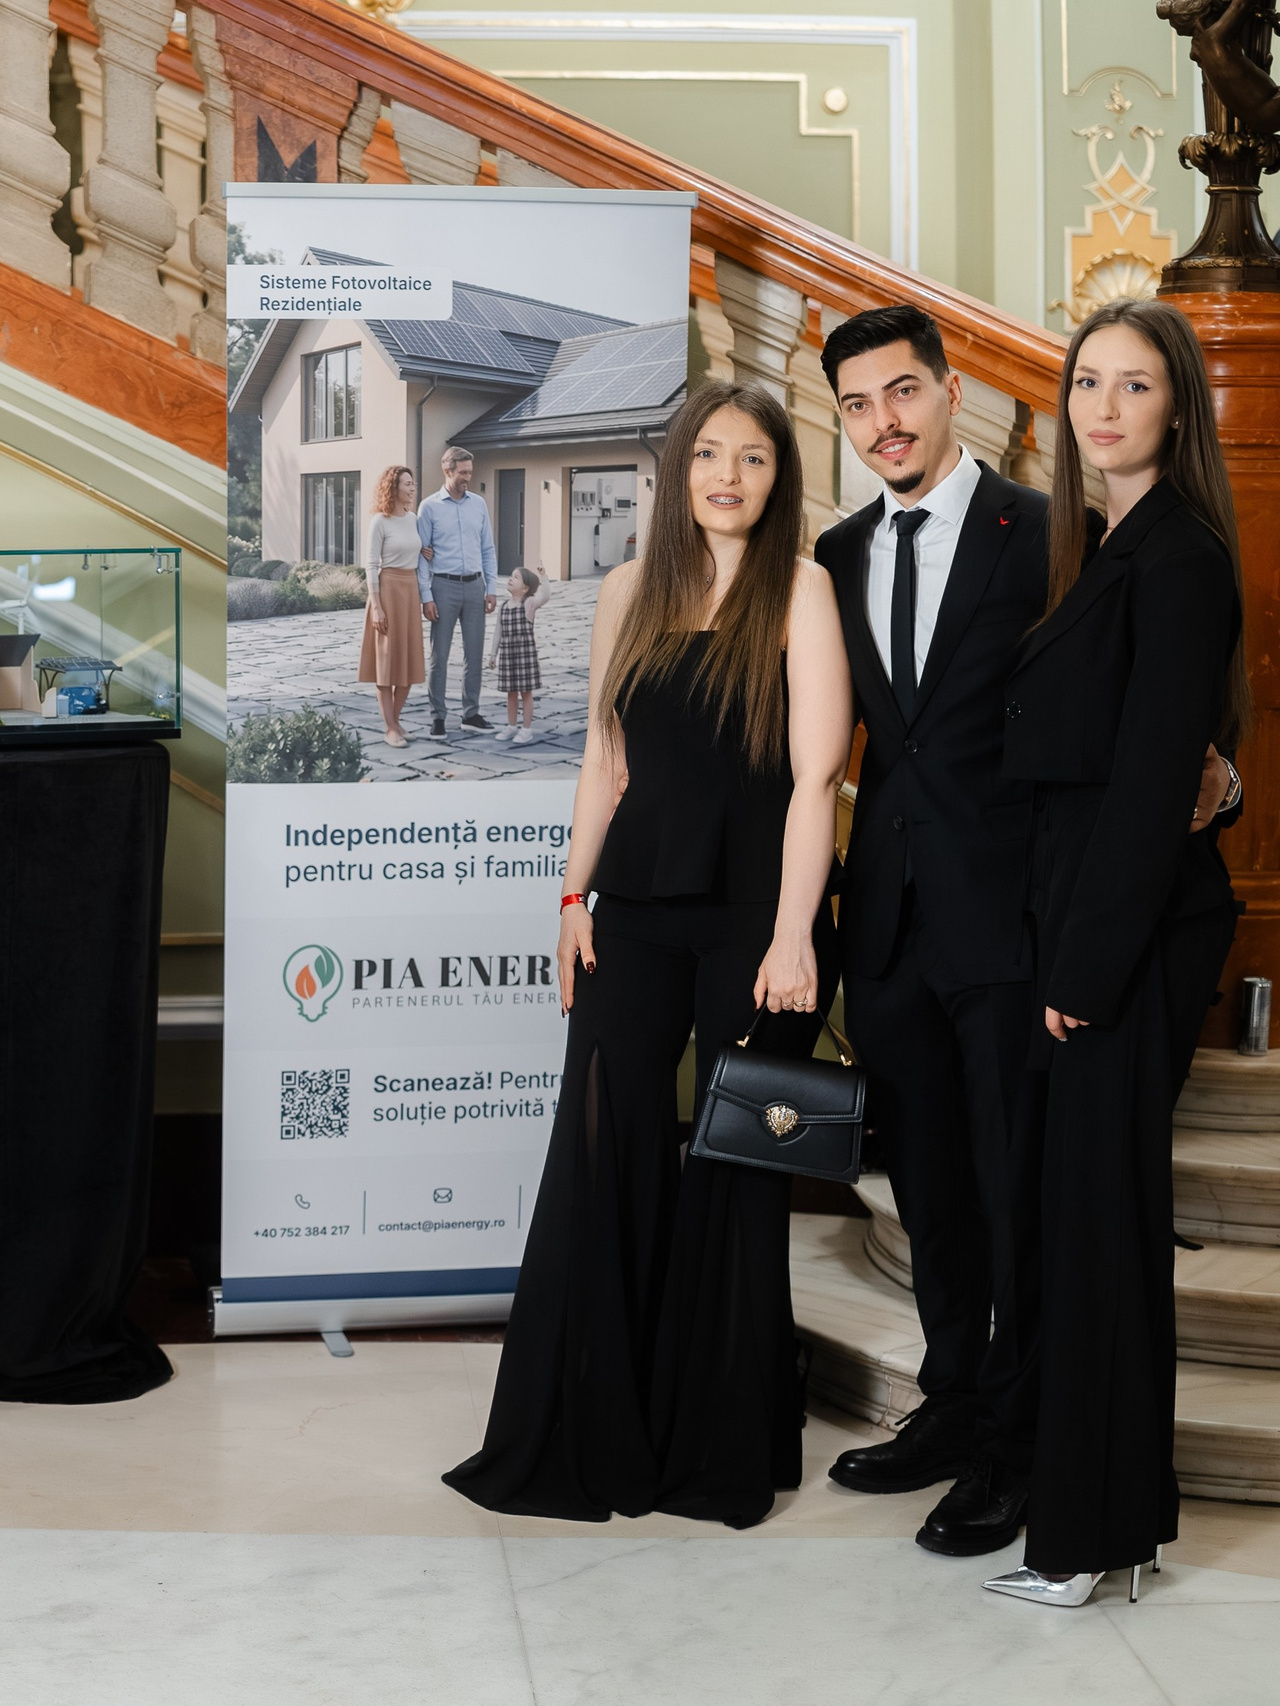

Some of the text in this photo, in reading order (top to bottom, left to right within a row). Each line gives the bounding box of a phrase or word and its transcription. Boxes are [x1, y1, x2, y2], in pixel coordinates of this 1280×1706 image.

[259, 274, 433, 291] Sisteme Fotovoltaice
[259, 296, 363, 315] Rezidențiale
[285, 819, 478, 851] Independență
[285, 860, 373, 888] pentru
[382, 862, 445, 880] casa
[454, 855, 476, 885] și
[352, 954, 554, 991] PIA ENER
[352, 994, 464, 1008] PARTENERUL
[473, 991, 504, 1006] TĂU
[373, 1071, 563, 1093] Scanează! Pentr
[373, 1101, 446, 1125] soluție
[454, 1098, 544, 1124] potrivită
[254, 1225, 350, 1238] +40 752 384 217
[378, 1219, 506, 1232] contact@piaenergy.ro
